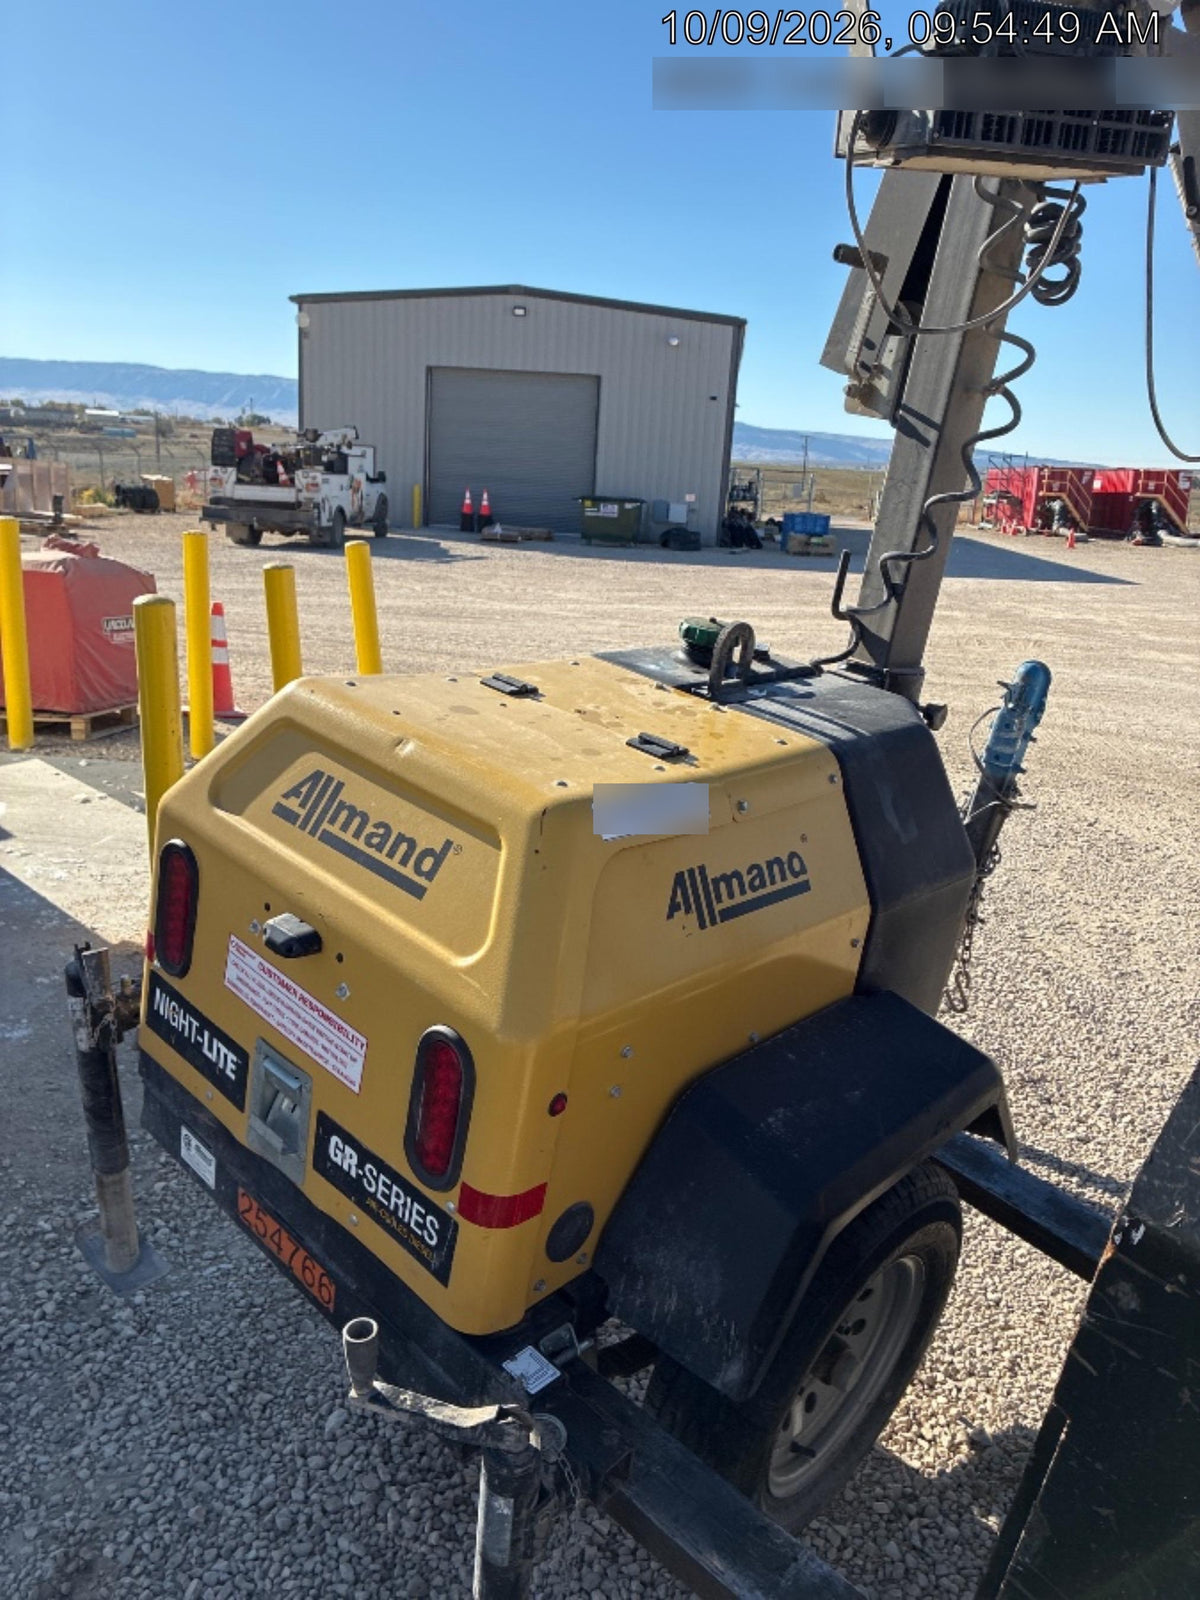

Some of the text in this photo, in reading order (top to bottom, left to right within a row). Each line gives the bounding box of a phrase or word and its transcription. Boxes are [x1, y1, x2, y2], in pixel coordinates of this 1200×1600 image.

[281, 769, 454, 883] Allmand
[154, 987, 238, 1082] NIGHT-LITE
[258, 961, 366, 1051] CUSTOMER RESPONSIBILITY
[328, 1134, 439, 1247] GR-SERIES
[238, 1189, 333, 1308] 254766
